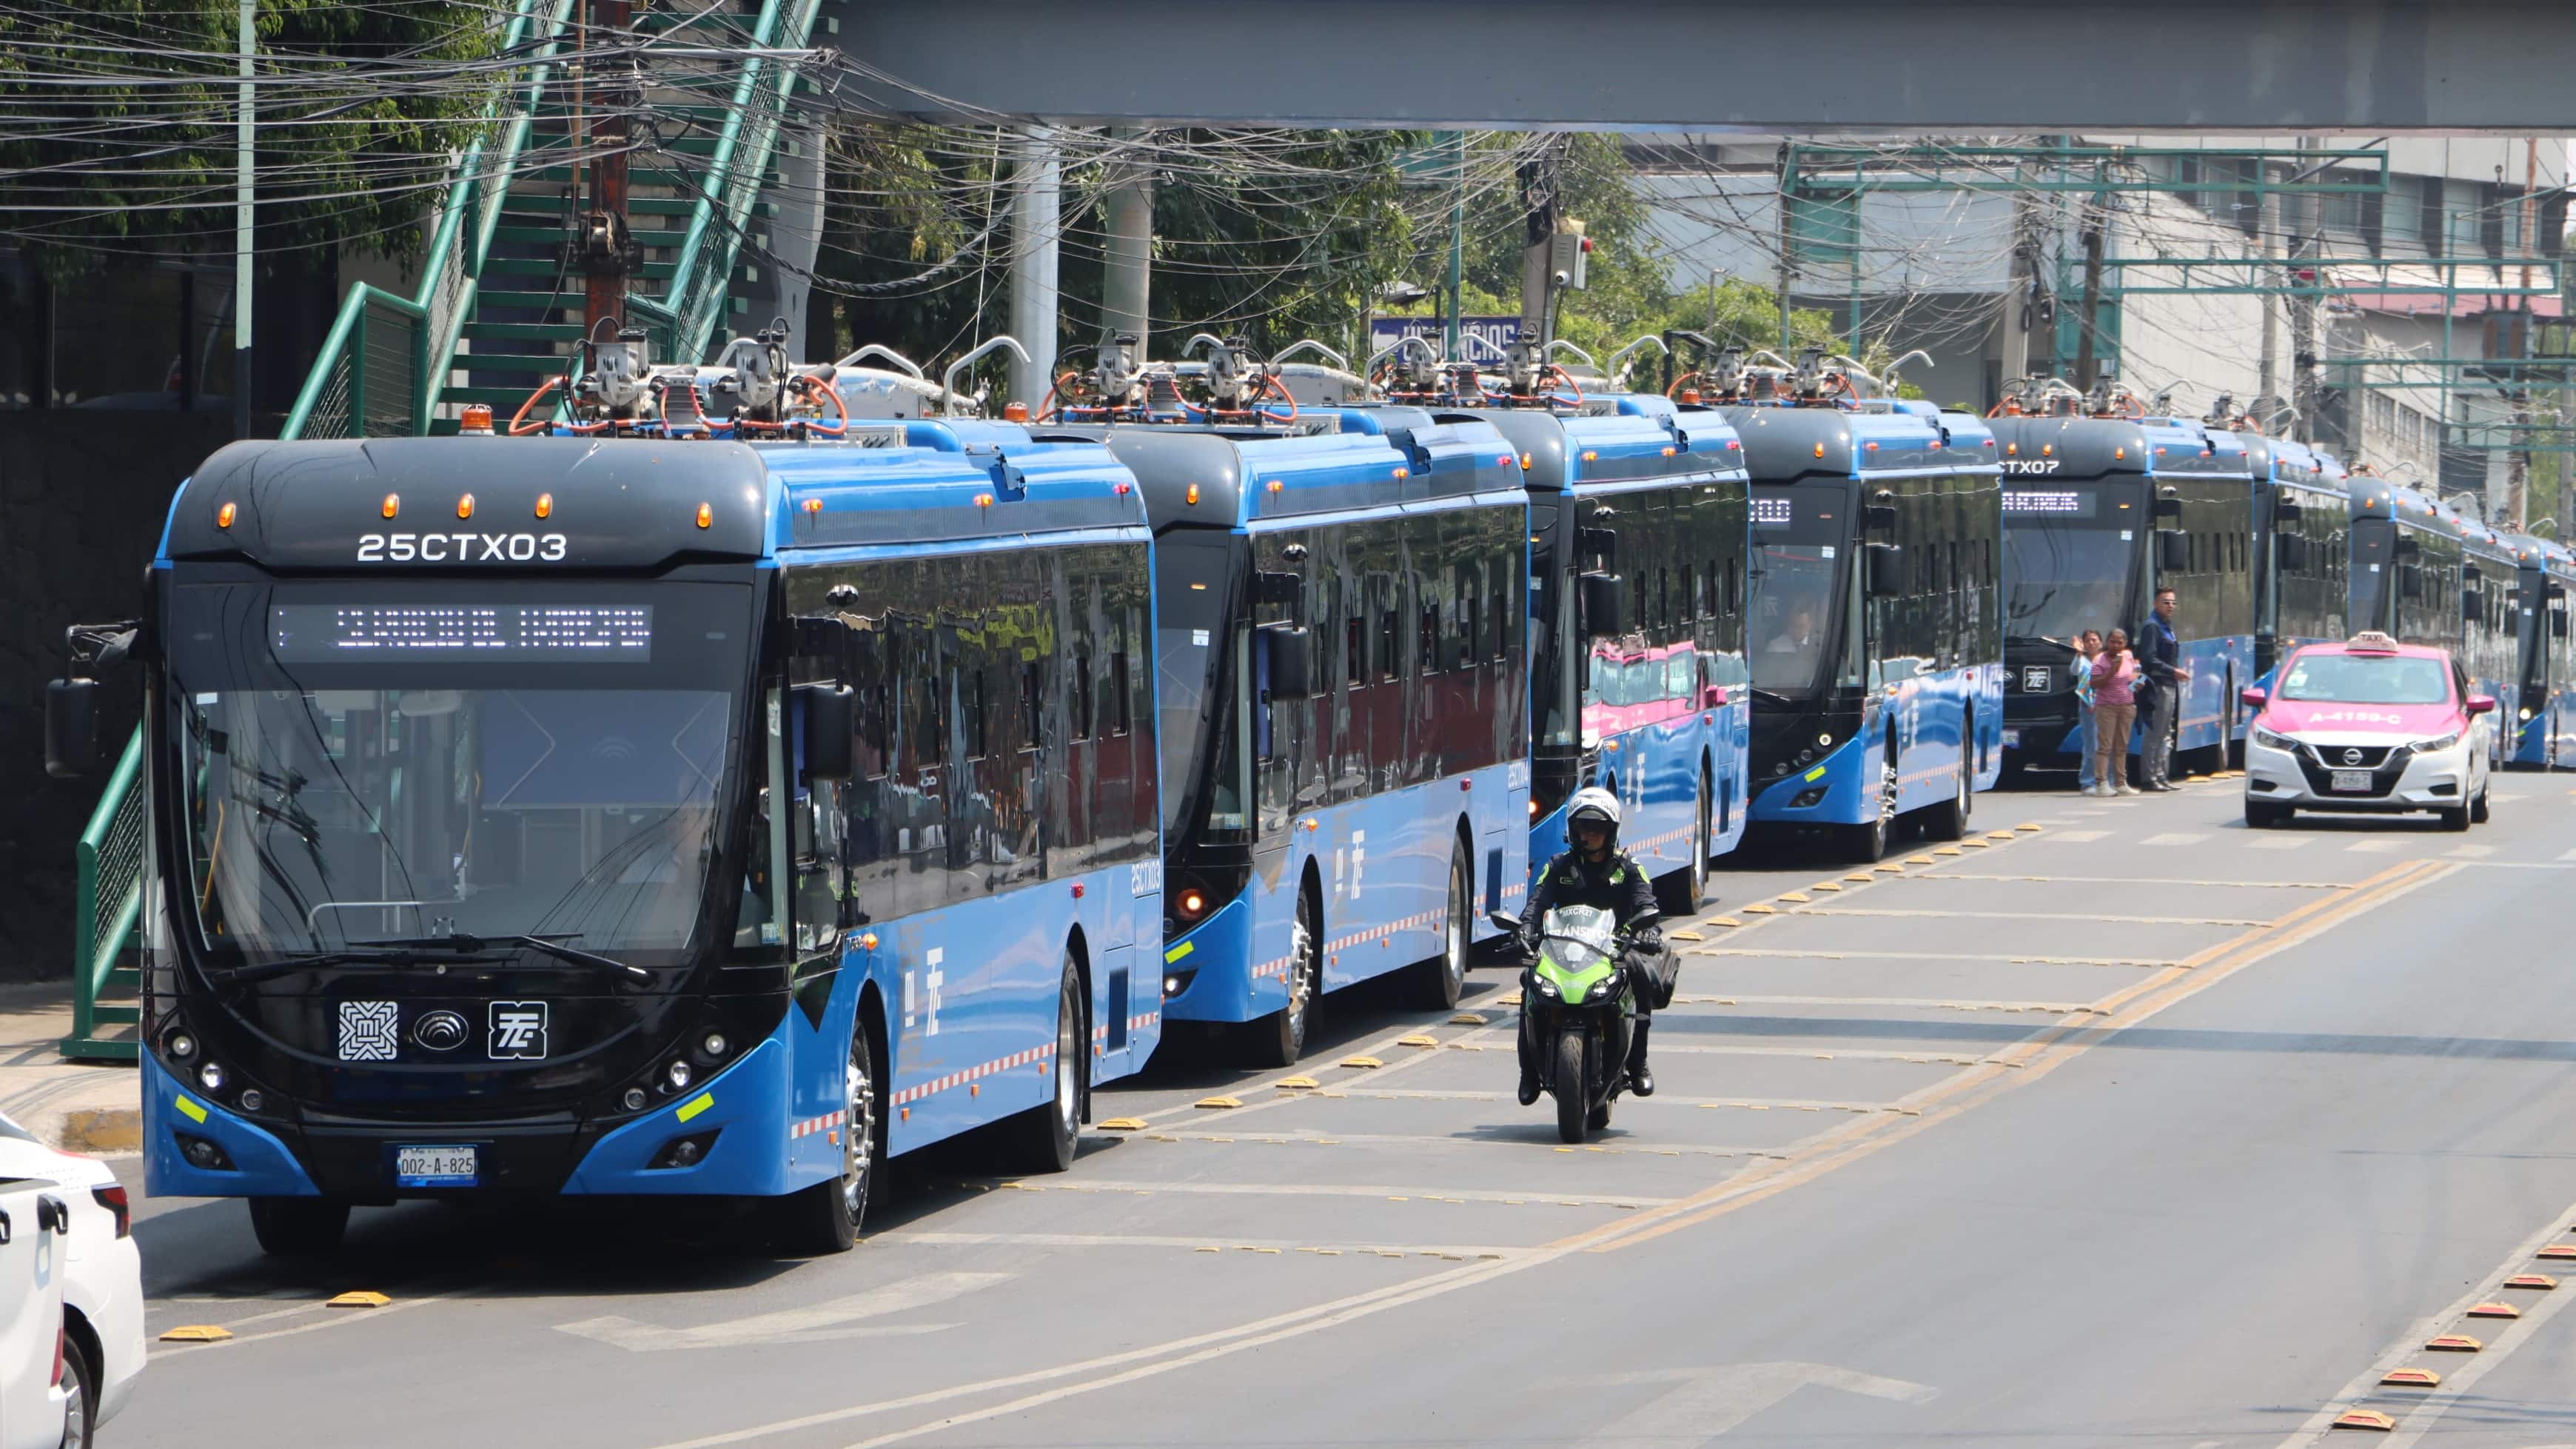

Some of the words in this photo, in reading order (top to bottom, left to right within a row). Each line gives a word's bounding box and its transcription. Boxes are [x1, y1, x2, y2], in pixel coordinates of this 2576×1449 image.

[358, 533, 567, 561] 25CTX03
[1131, 859, 1161, 894] 25CTX03
[401, 1157, 474, 1174] 002-A-825
